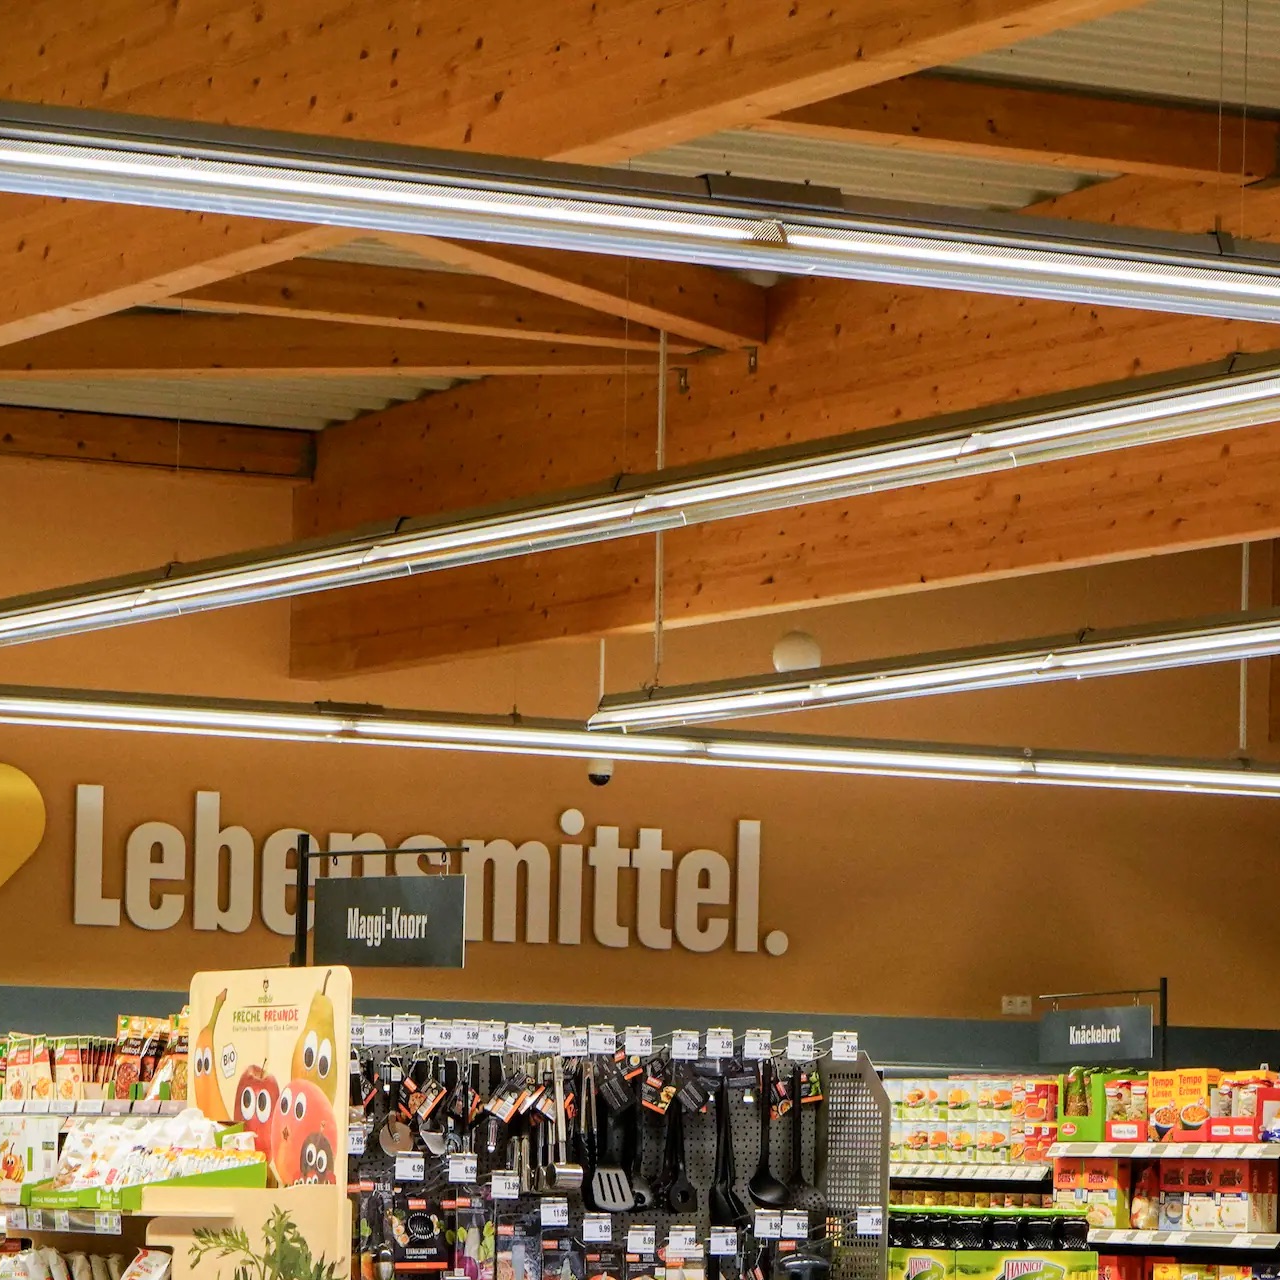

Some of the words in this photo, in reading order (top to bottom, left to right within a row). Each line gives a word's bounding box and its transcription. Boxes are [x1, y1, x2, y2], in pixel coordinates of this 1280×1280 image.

[347, 907, 429, 947] Maggi-Knorr
[232, 1009, 261, 1024] FRECHE
[263, 1008, 299, 1022] FREUNDE
[1068, 1023, 1122, 1046] Knäckebrot
[1152, 1077, 1174, 1089] Tempo
[1178, 1074, 1202, 1087] Tempo
[1152, 1088, 1173, 1098] Linsen
